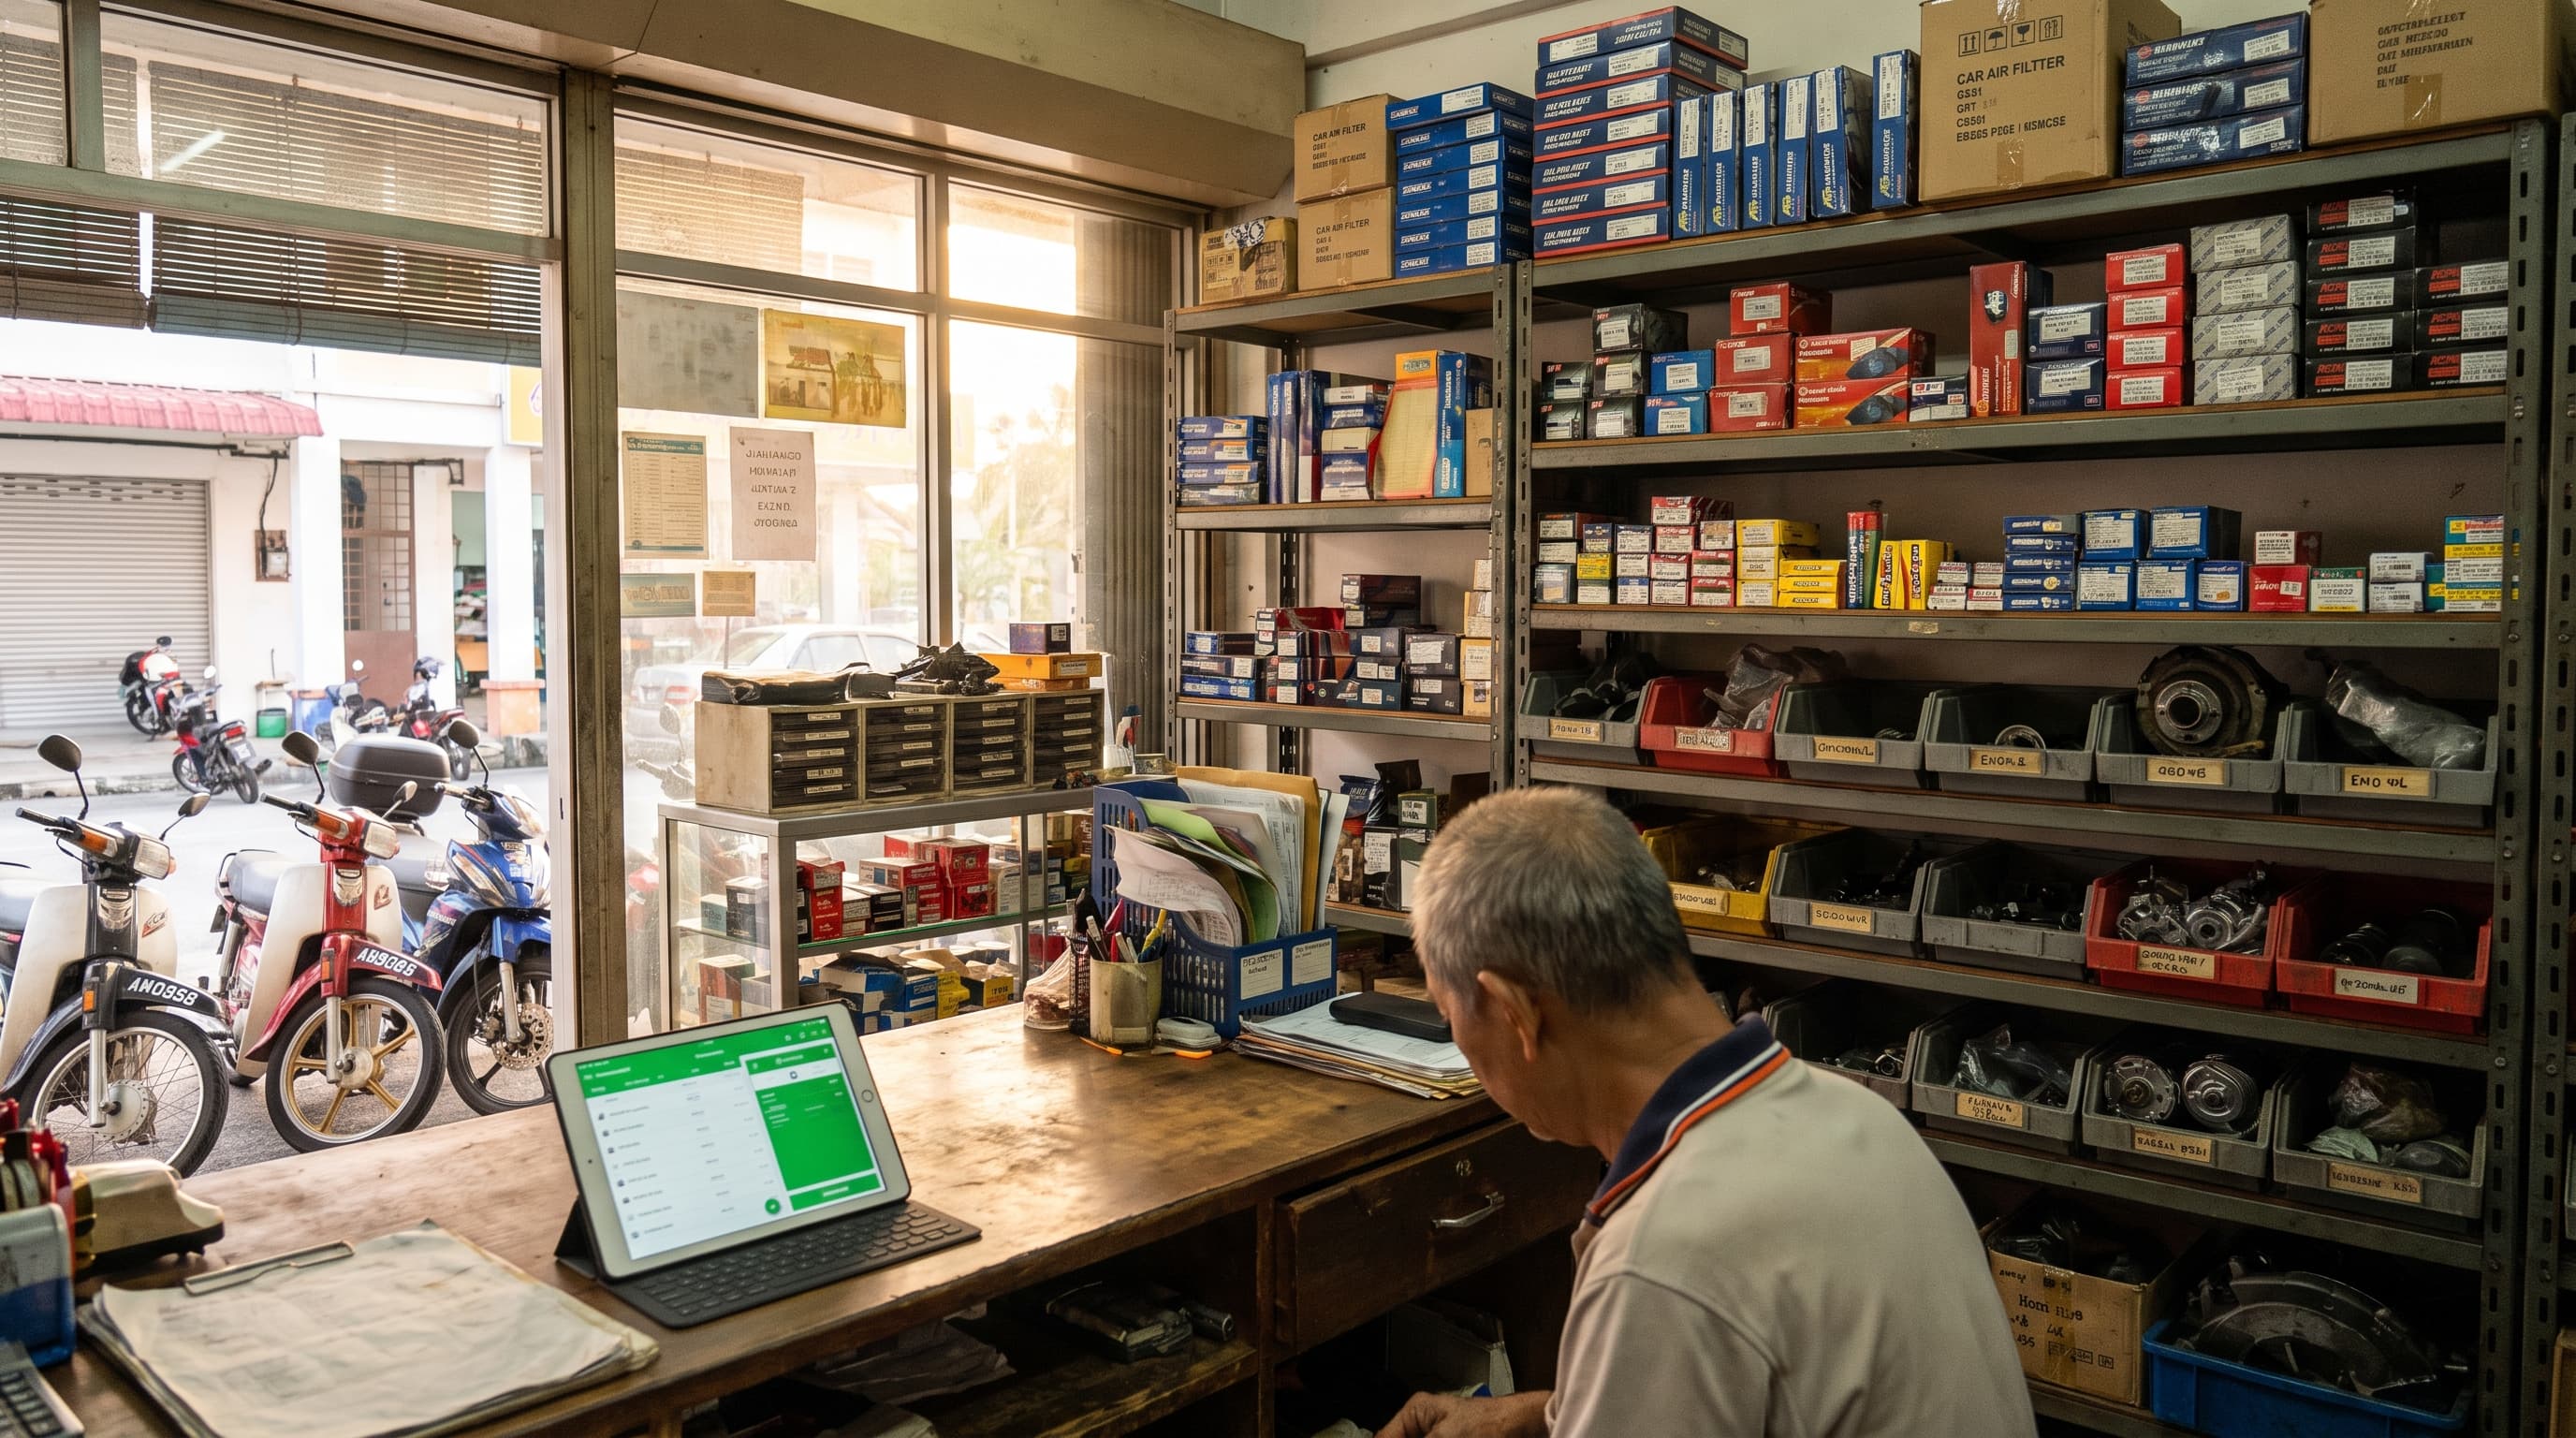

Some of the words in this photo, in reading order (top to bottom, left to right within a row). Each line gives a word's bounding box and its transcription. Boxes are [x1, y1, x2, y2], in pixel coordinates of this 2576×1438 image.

[1956, 70, 1984, 85] CAR
[1986, 66, 2009, 81] AIR
[2012, 55, 2065, 75] FILTTER
[1312, 131, 1327, 141] CAR
[1341, 123, 1367, 135] FILTER
[1316, 225, 1330, 235] CAR
[1344, 218, 1370, 230] FILTER
